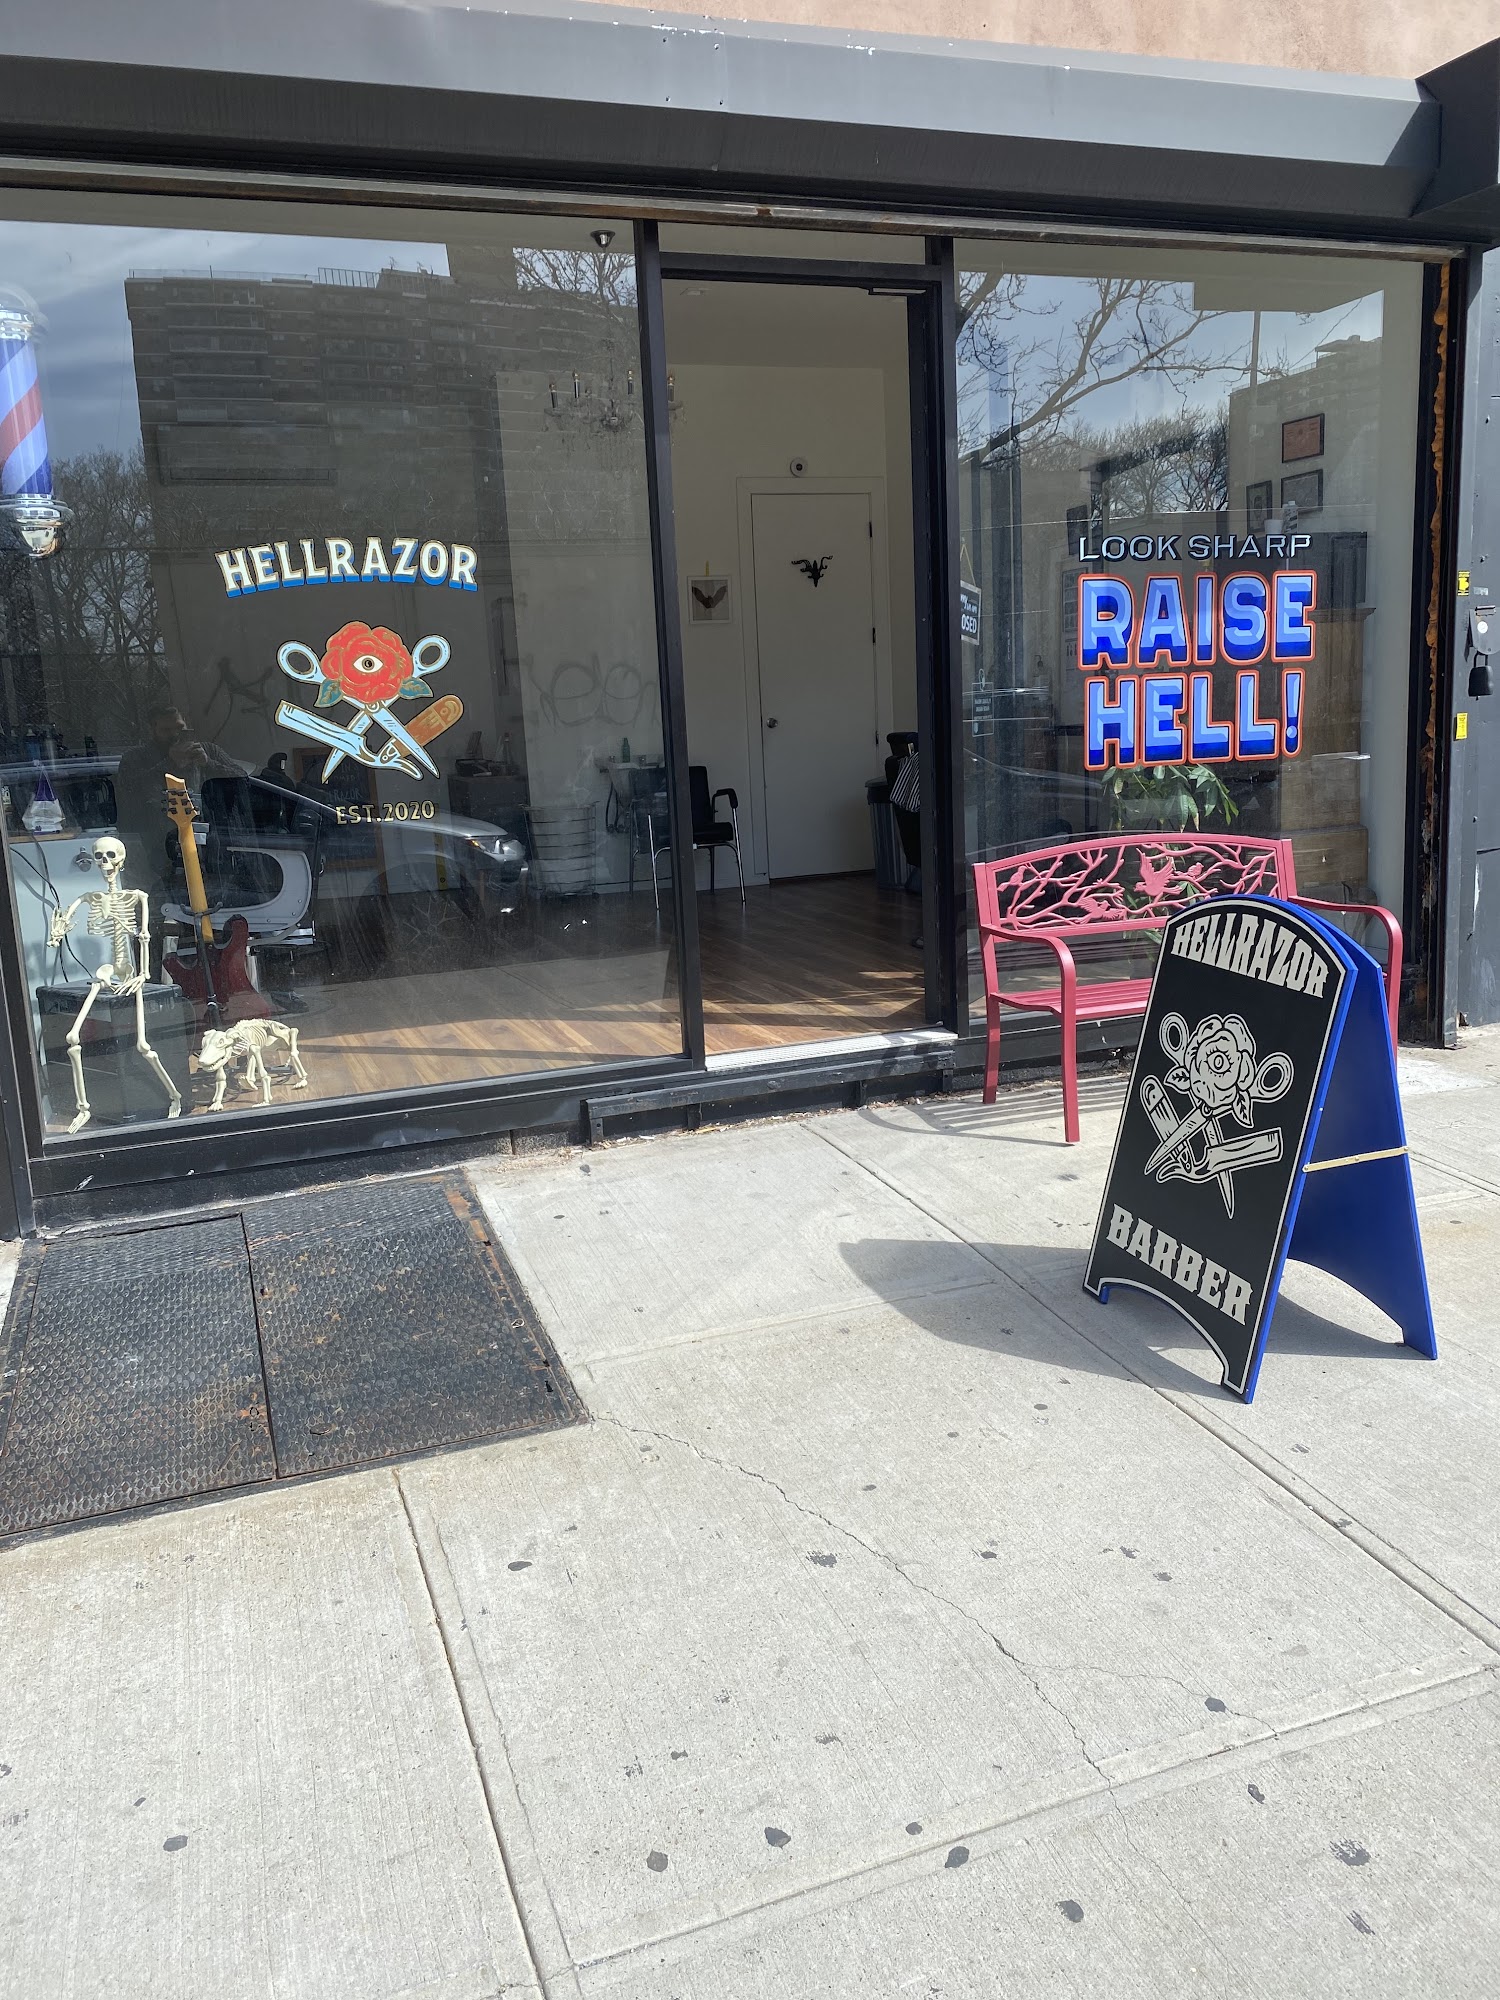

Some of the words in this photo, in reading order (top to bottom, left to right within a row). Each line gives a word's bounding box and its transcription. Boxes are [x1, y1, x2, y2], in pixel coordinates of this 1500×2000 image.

[215, 536, 478, 598] HELLRAZOR
[1078, 534, 1182, 562] LOOK
[1187, 533, 1312, 561] SHARP
[961, 613, 977, 633] OSED
[1078, 570, 1318, 671] RAISE
[1084, 667, 1306, 771] HELL!
[1170, 912, 1330, 999] HELLRAZOR
[1106, 1203, 1254, 1326] BARBER
